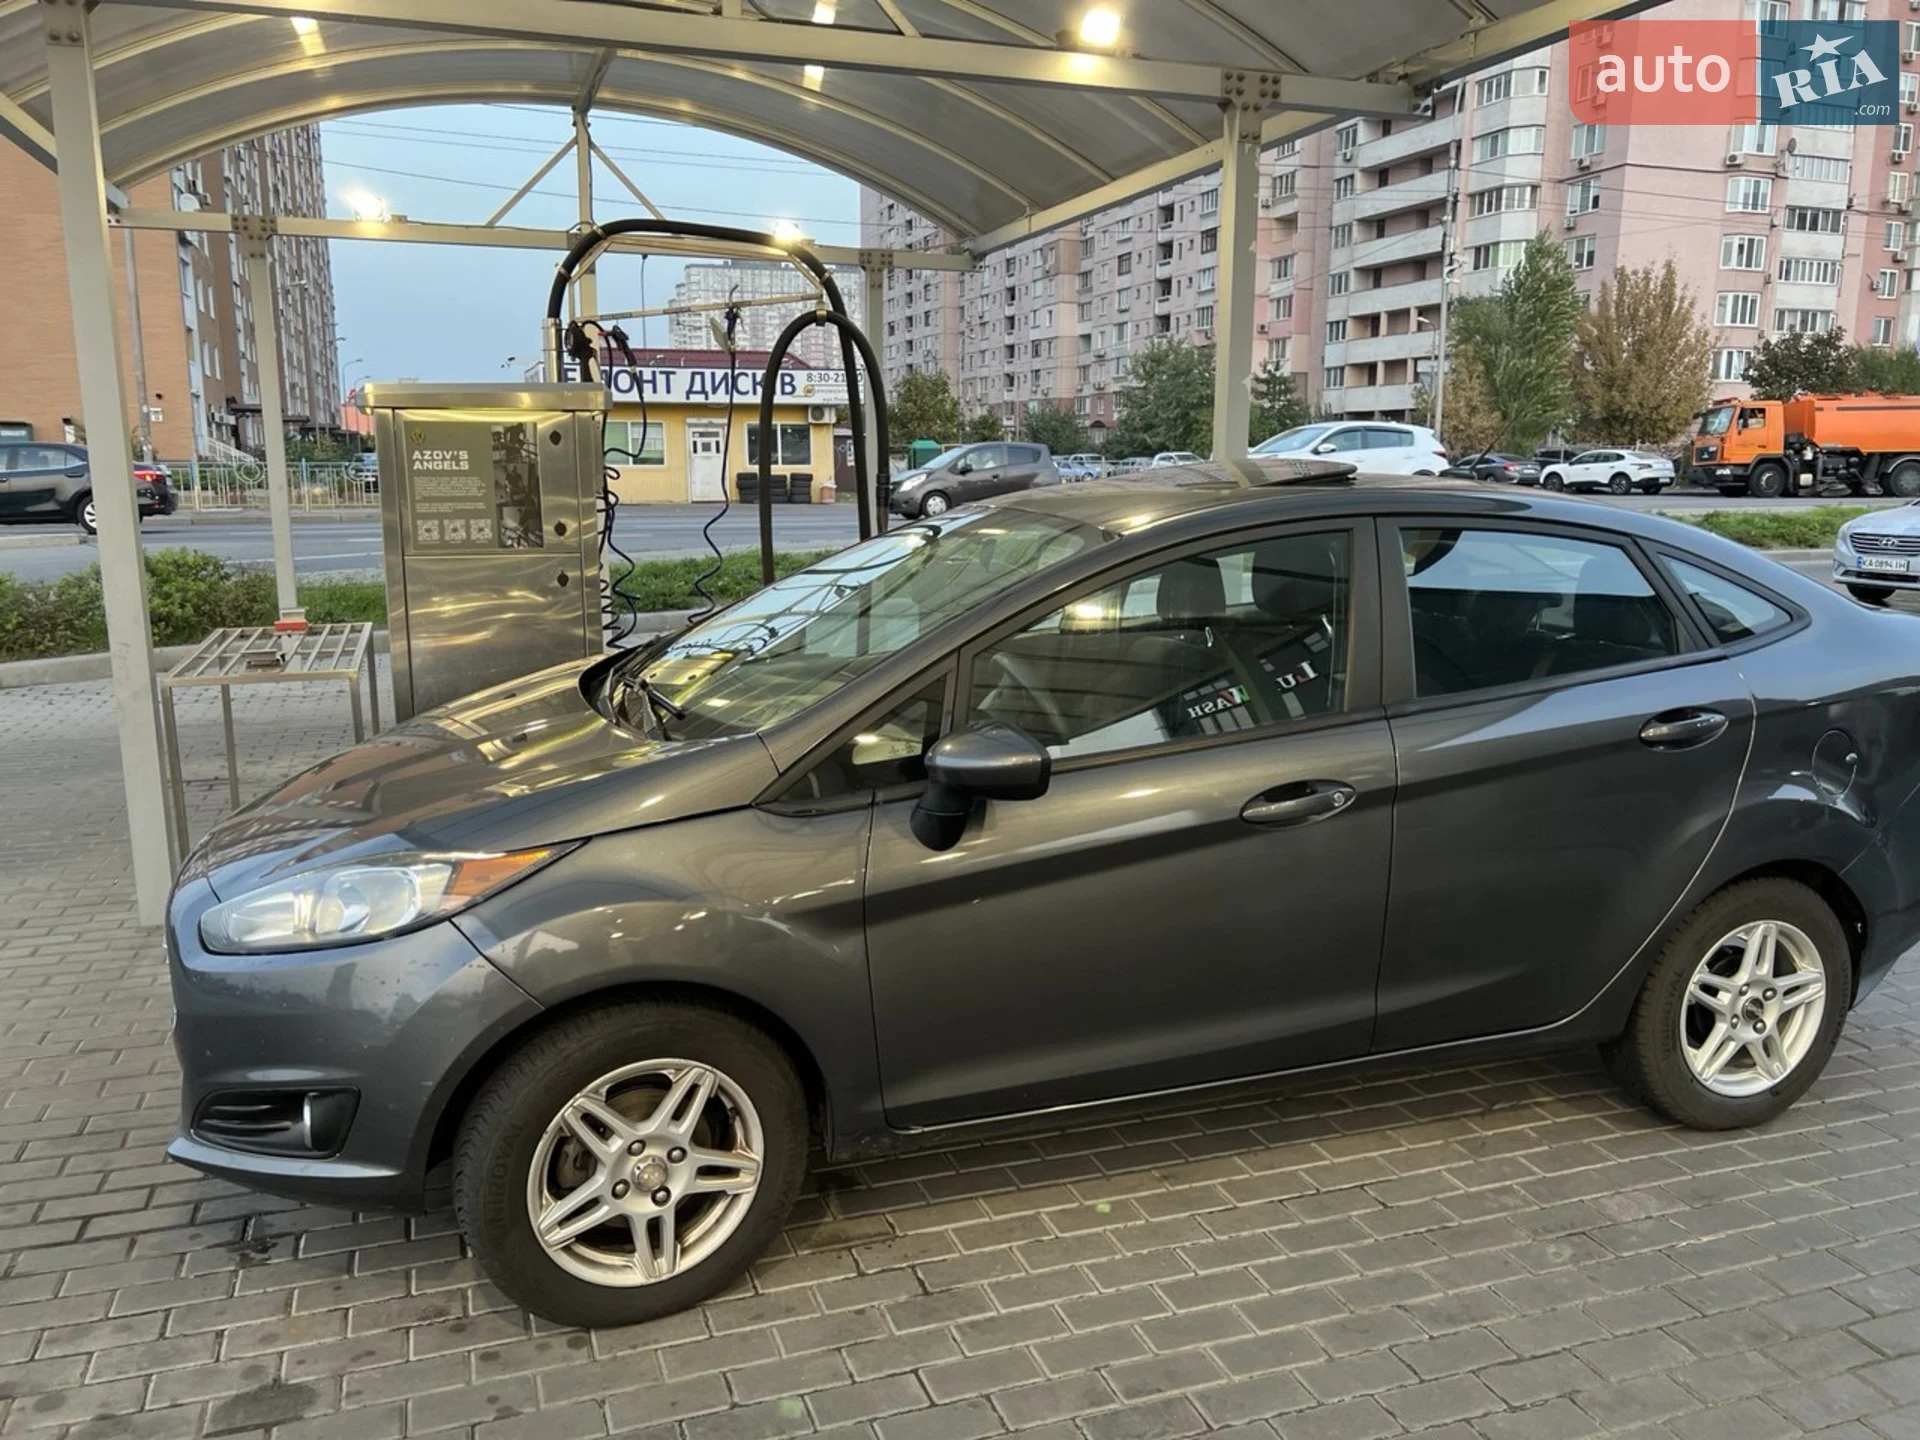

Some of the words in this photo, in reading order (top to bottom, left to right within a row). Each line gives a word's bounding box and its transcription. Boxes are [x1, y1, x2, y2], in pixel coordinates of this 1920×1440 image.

[806, 372, 863, 383] 8:30-210
[684, 371, 797, 401] ДИСКВ
[412, 450, 469, 460] AZOV'S
[413, 460, 469, 470] ANGELS
